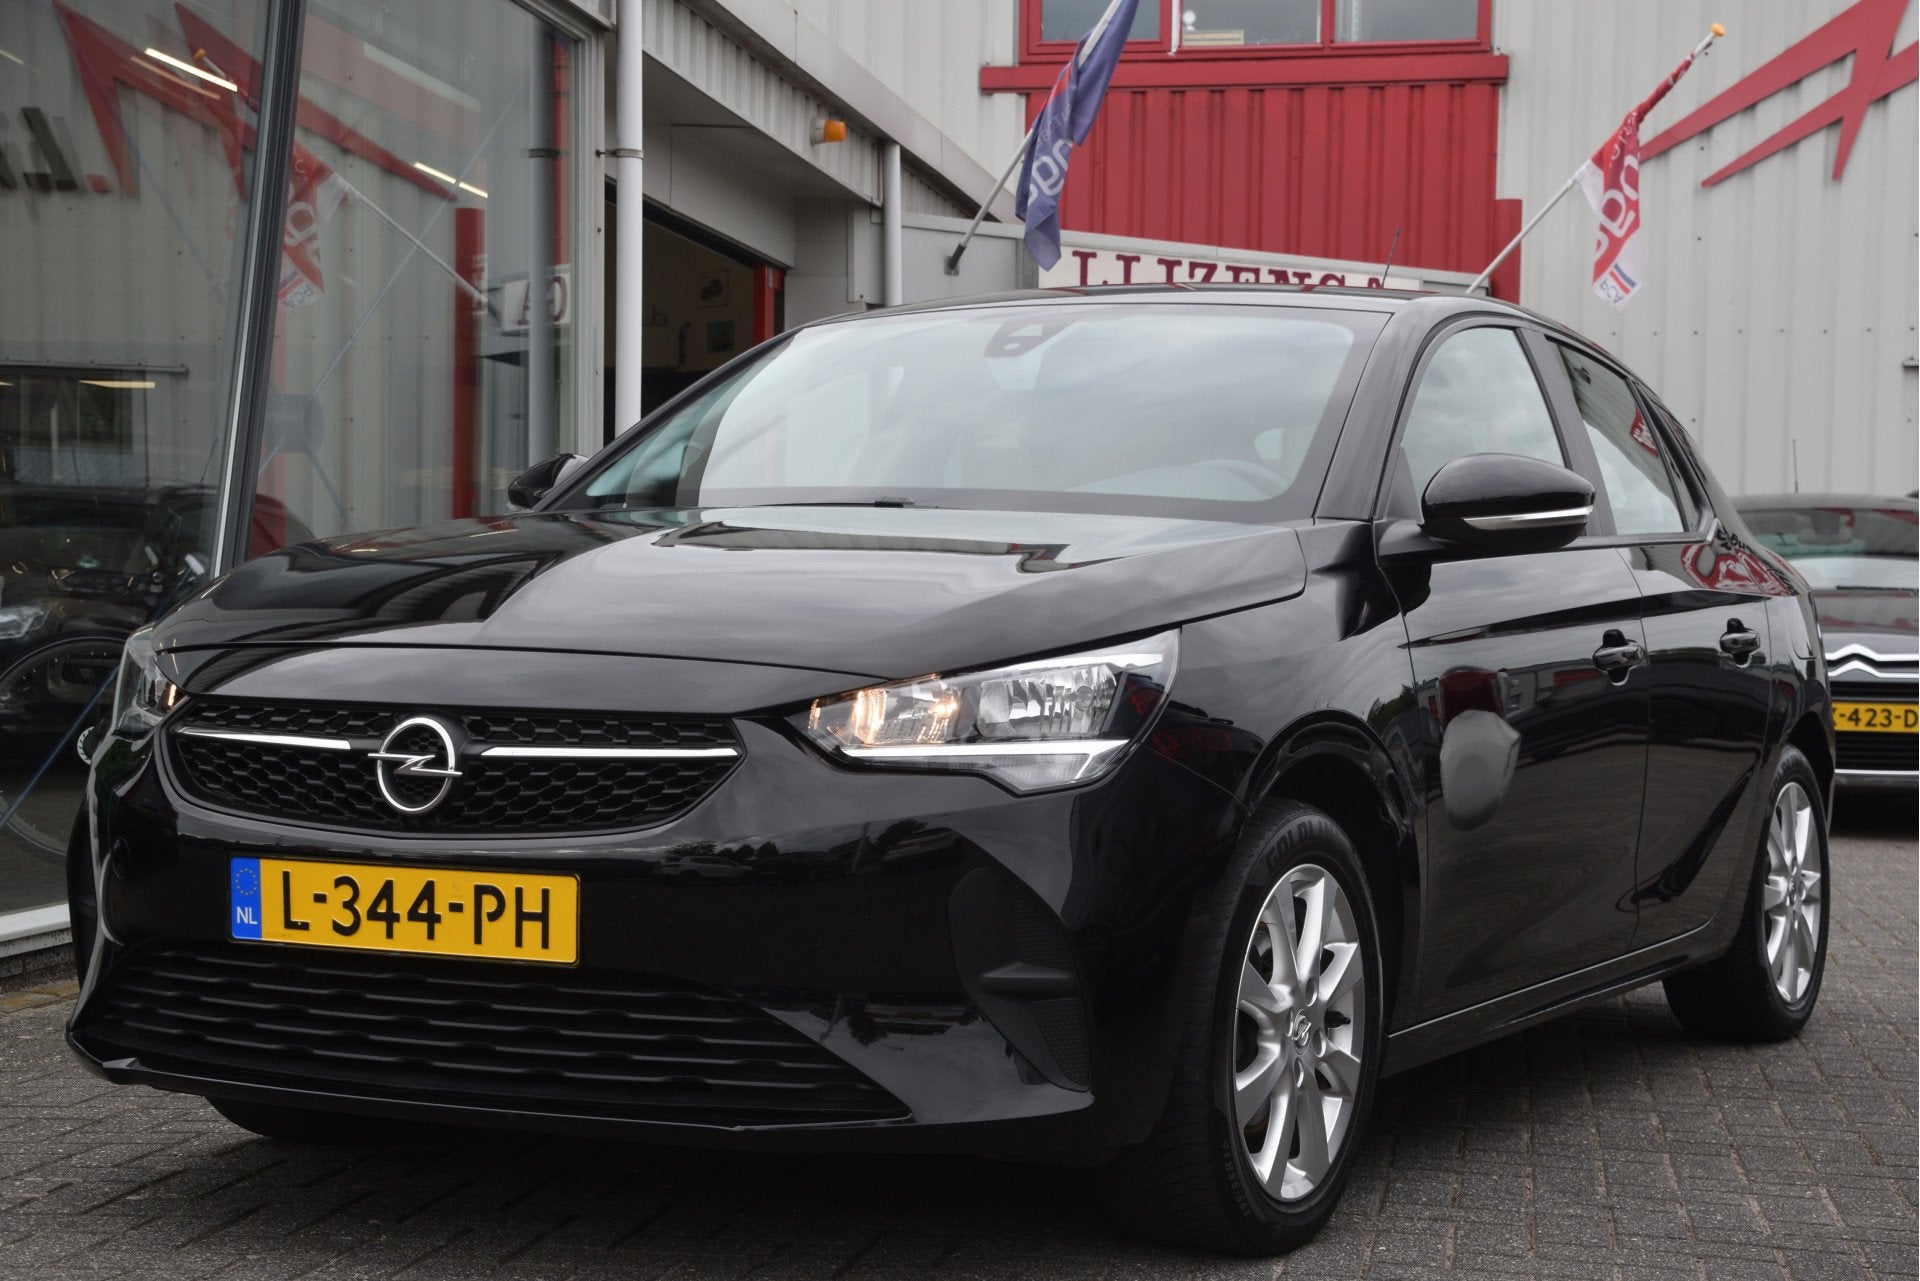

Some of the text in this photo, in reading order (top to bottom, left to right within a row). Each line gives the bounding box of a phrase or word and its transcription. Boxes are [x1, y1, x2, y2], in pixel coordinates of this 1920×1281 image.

[1833, 707, 1918, 728] -423-D
[236, 906, 258, 926] NL
[282, 870, 551, 950] L-344-PH
